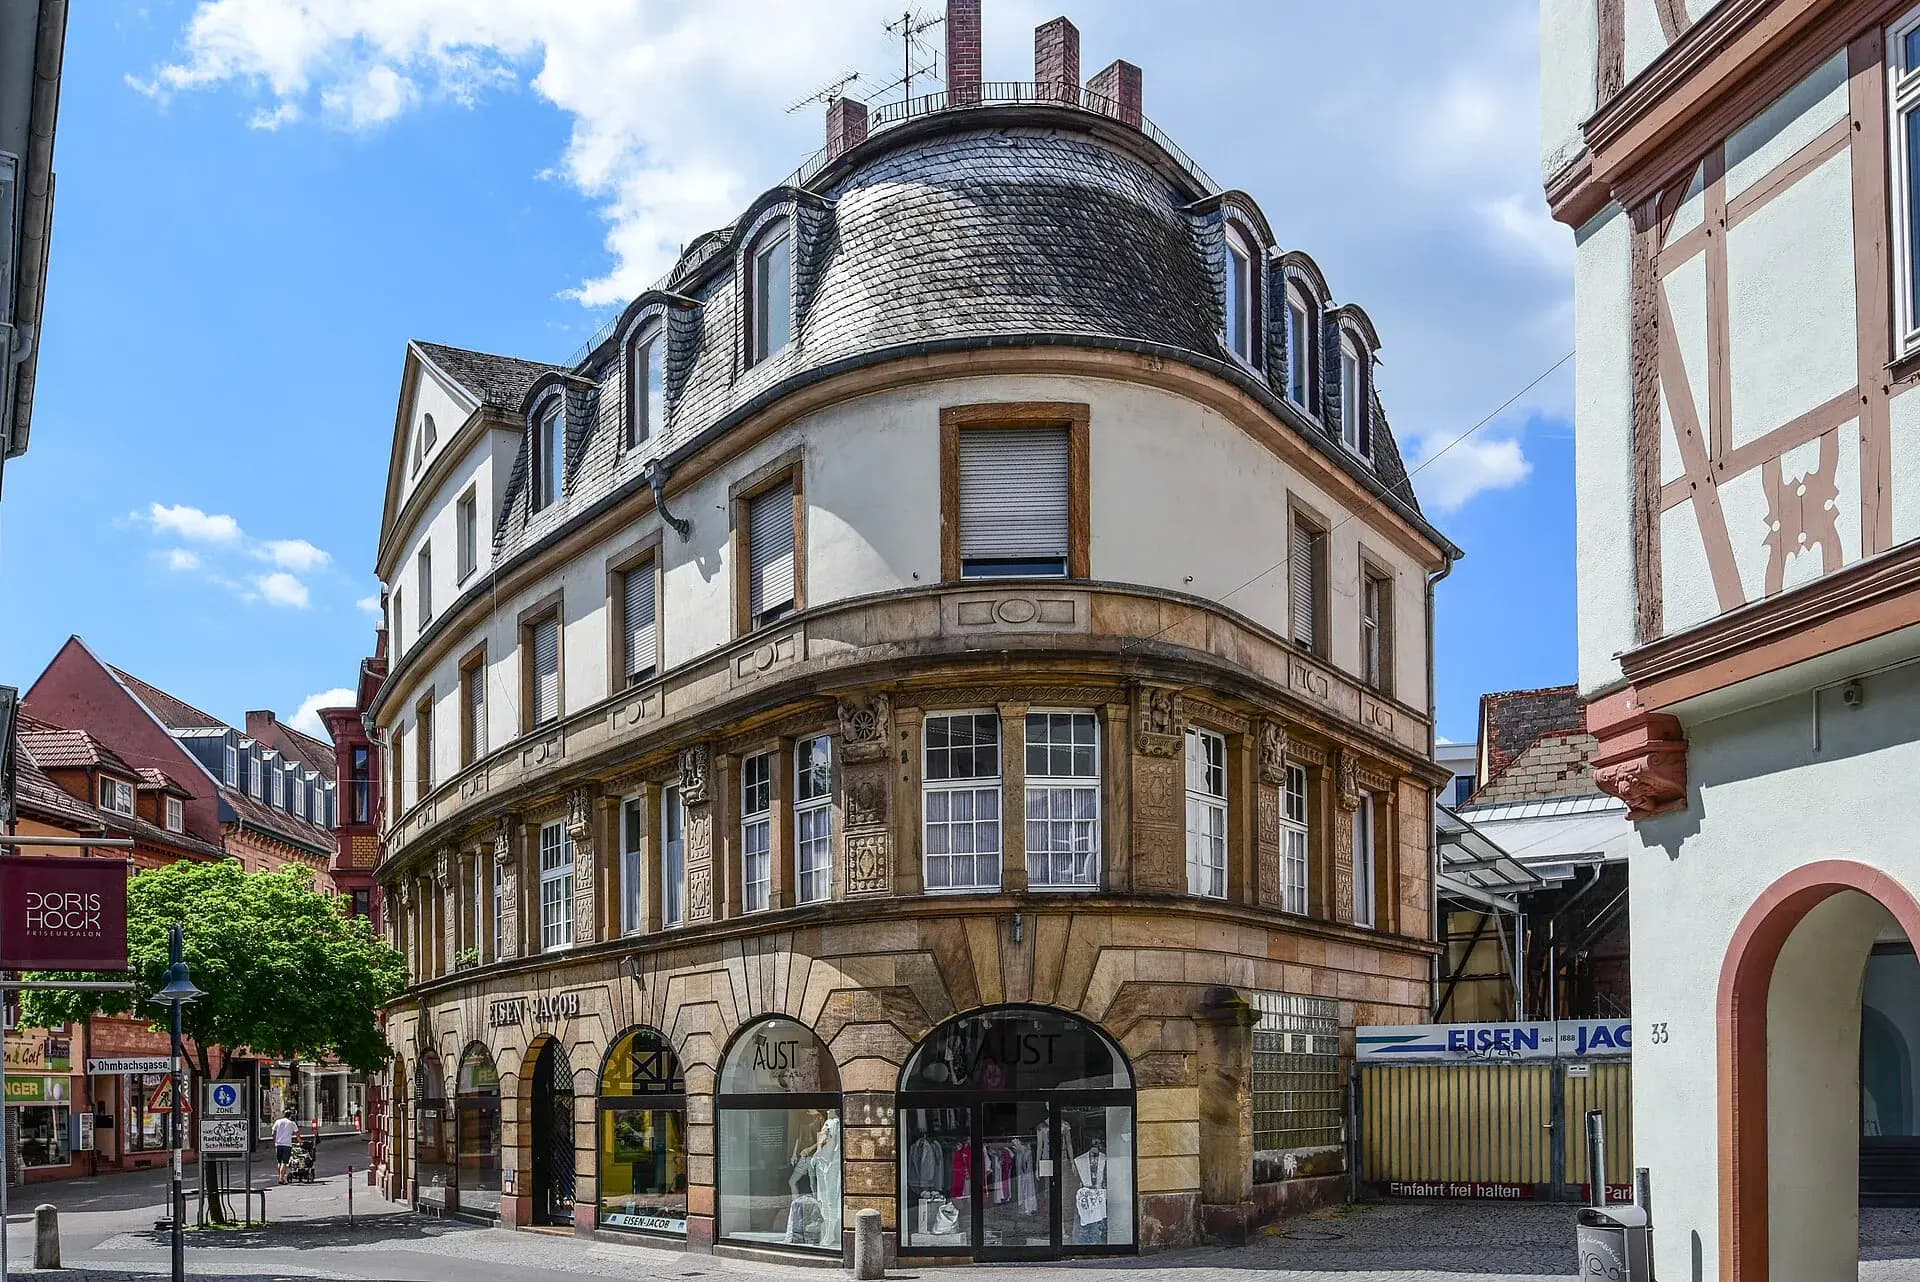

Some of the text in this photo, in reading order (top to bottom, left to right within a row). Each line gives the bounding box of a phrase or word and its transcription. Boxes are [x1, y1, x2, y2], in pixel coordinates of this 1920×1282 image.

[26, 892, 101, 911] DORIS
[26, 910, 101, 930] HOCK
[488, 993, 580, 1024] EISEN JACOB
[1447, 1027, 1539, 1052] EISEN
[1541, 1035, 1553, 1043] seit
[1560, 1034, 1576, 1042] 1888
[1651, 1022, 1669, 1045] 33
[22, 1043, 44, 1066] Golf
[752, 1040, 799, 1071] AUST
[98, 1060, 168, 1072] Ohmbachsgasse
[1390, 1182, 1521, 1199] Einfahrt frei halten
[623, 1215, 671, 1229] EISEN-JACOB
